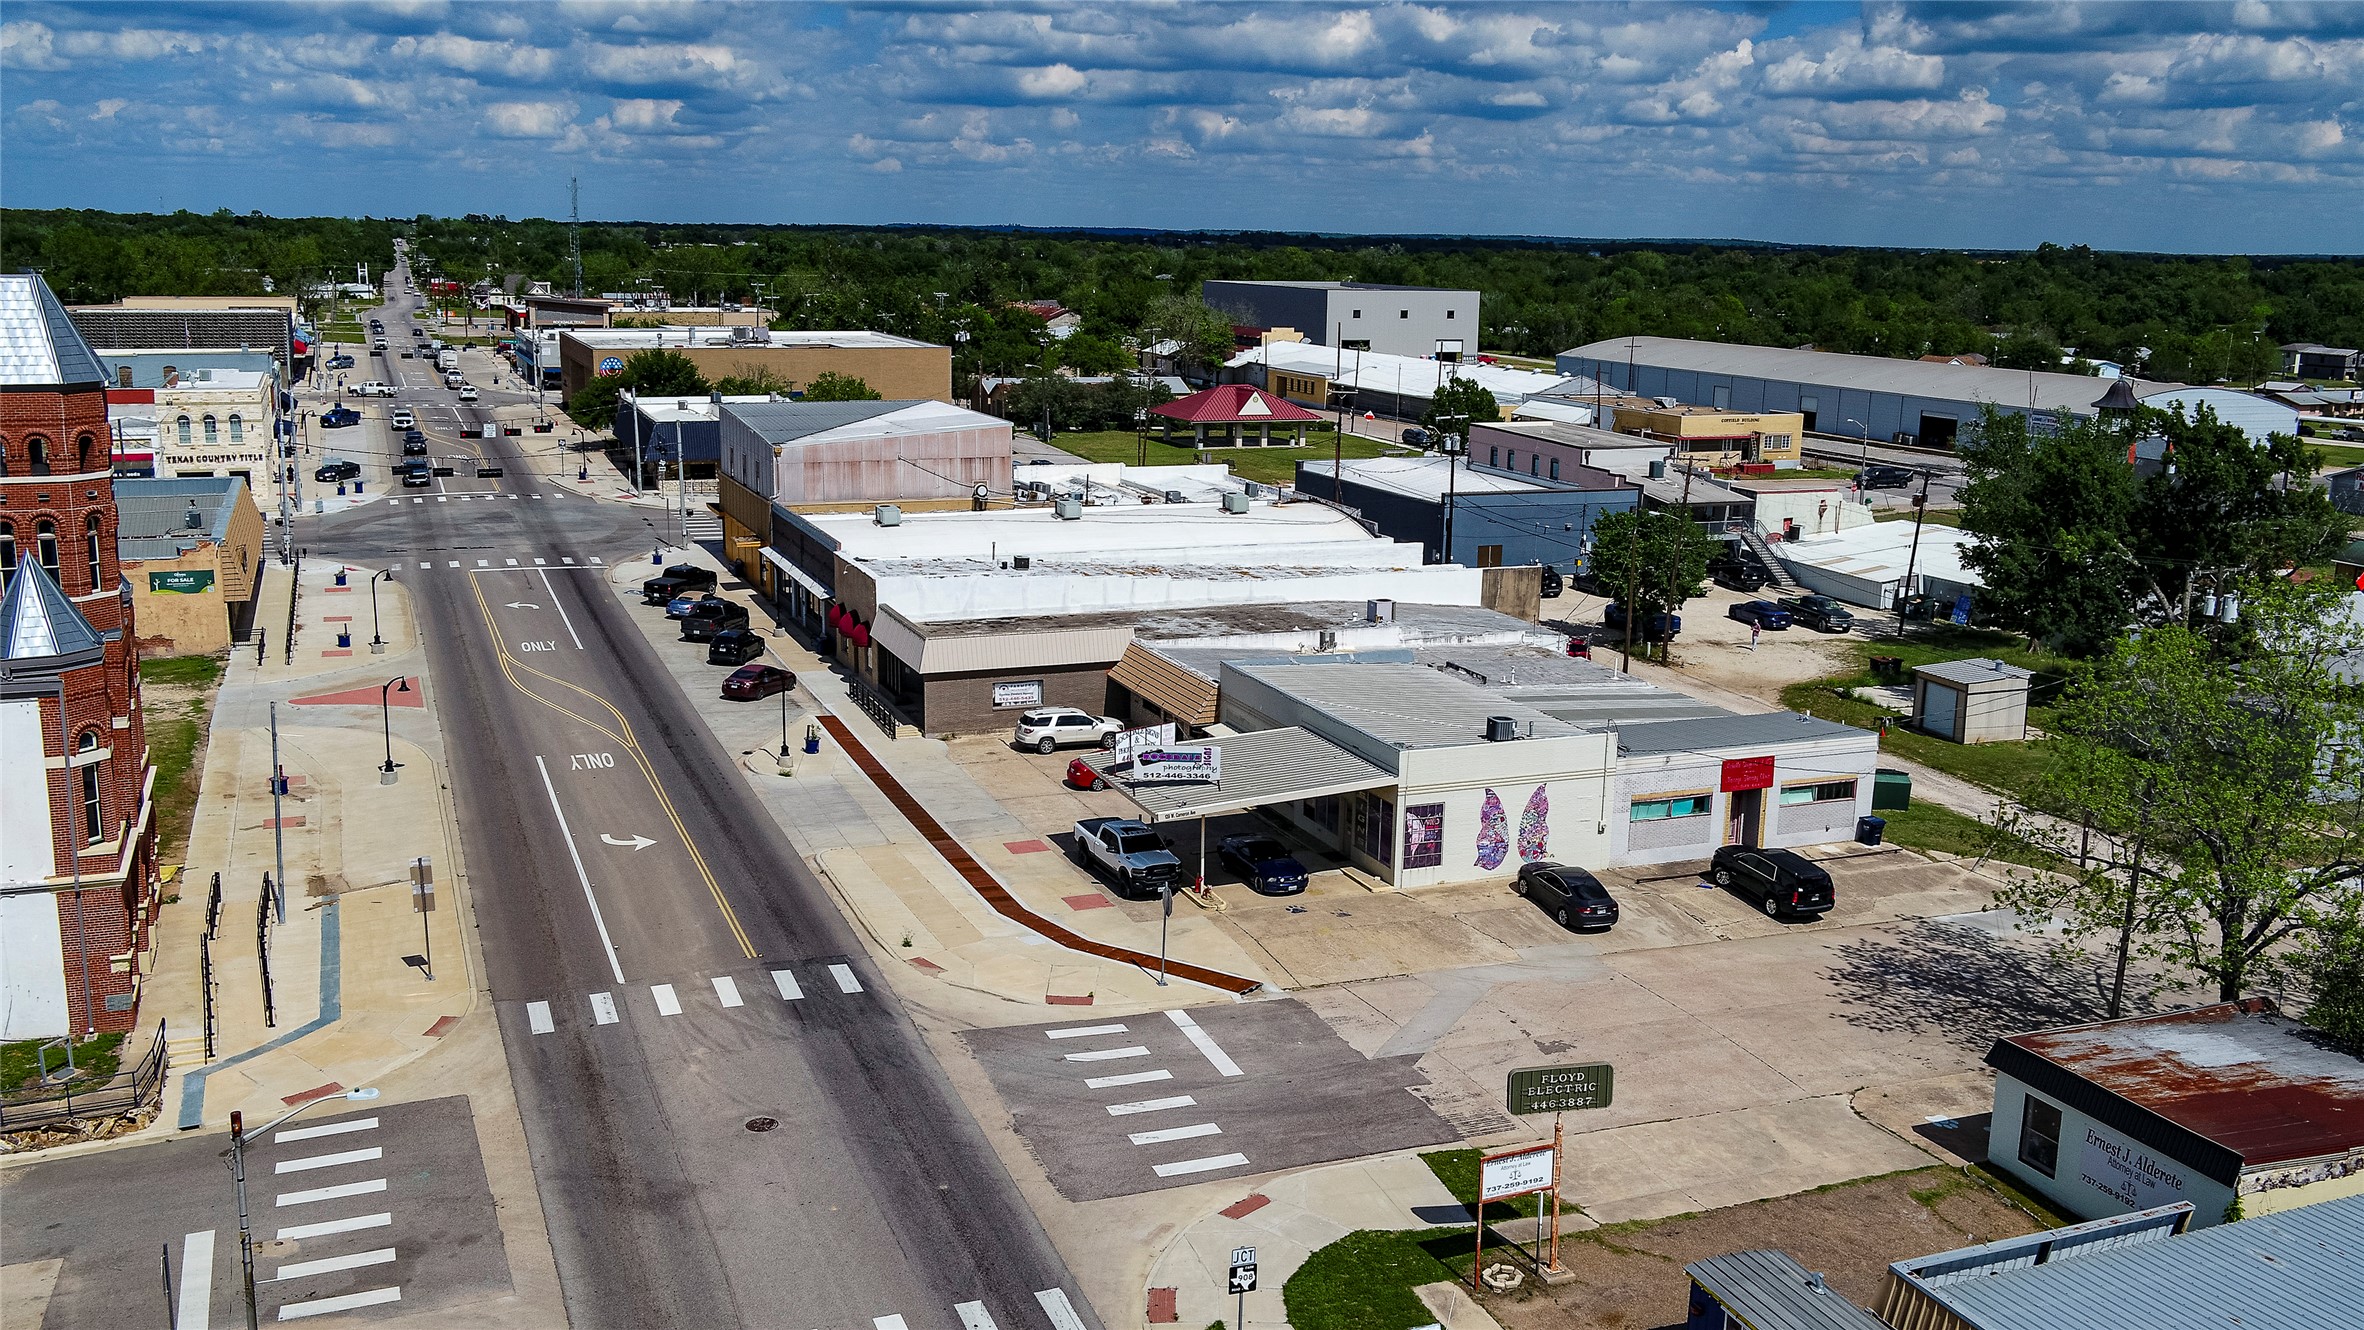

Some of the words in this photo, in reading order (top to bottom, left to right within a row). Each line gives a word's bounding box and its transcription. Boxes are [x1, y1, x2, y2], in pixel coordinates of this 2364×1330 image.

[166, 455, 194, 464] TEXAS
[196, 454, 237, 463] COUNTRY
[239, 453, 263, 462] TITLE
[521, 640, 556, 652] ONLY
[571, 752, 615, 770] ONLY
[1203, 747, 1212, 766] SIGNS
[1541, 1072, 1585, 1084] FLOYD
[1527, 1082, 1597, 1096] ELECTRIC
[1485, 1157, 1509, 1168] Ernest
[1517, 1151, 1547, 1161] Alderete
[1500, 1163, 1518, 1171] Attorney
[2085, 1128, 2122, 1159] Ernest
[2122, 1148, 2132, 1165] J.
[2134, 1154, 2182, 1190] Alderete
[2107, 1155, 2134, 1179] Attorney
[2134, 1171, 2142, 1181] at
[2142, 1173, 2157, 1189] Law
[1486, 1176, 1544, 1193] 737-259-9192
[2081, 1173, 2135, 1209] 737-259-9192
[1233, 1249, 1254, 1264] JCT
[1238, 1273, 1253, 1281] 908
